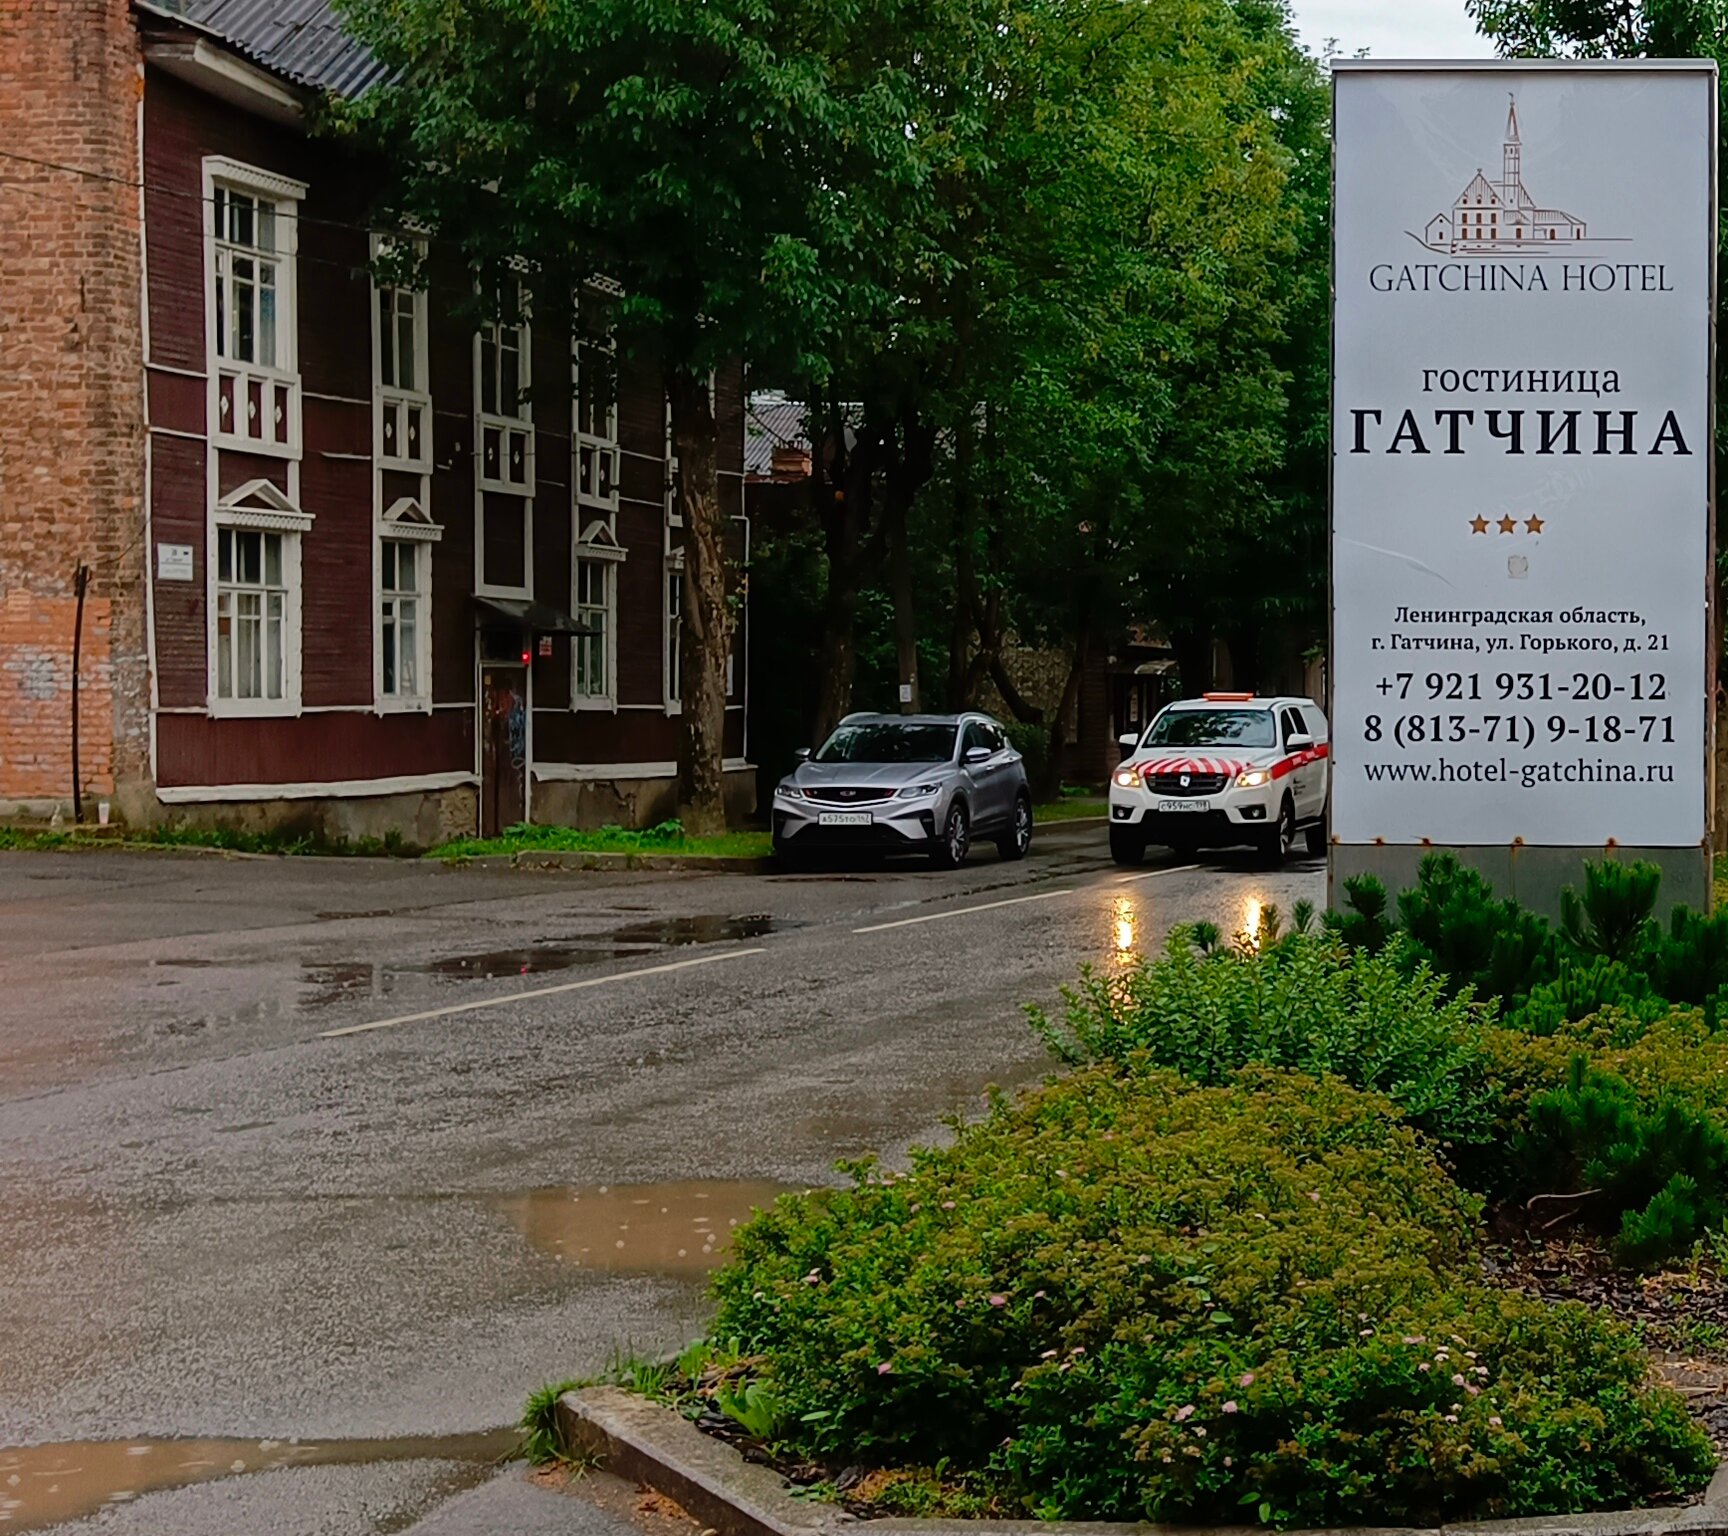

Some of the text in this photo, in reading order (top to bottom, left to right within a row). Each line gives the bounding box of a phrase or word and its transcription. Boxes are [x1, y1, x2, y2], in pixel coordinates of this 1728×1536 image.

[1369, 263, 1675, 293] GATCHINA HOTEL
[1421, 367, 1621, 396] гостиница
[1349, 408, 1693, 456] ГАТЧИНА
[1394, 605, 1646, 628] Ленинградская область,
[1371, 633, 1669, 655] г. Гатчина, ул. Горького, д. 21
[1376, 672, 1667, 701] +7 921 931-20-12
[1364, 714, 1676, 750] 8 (813-71) 9-18-71
[1364, 757, 1675, 789] www.hotel-gatchina.ru
